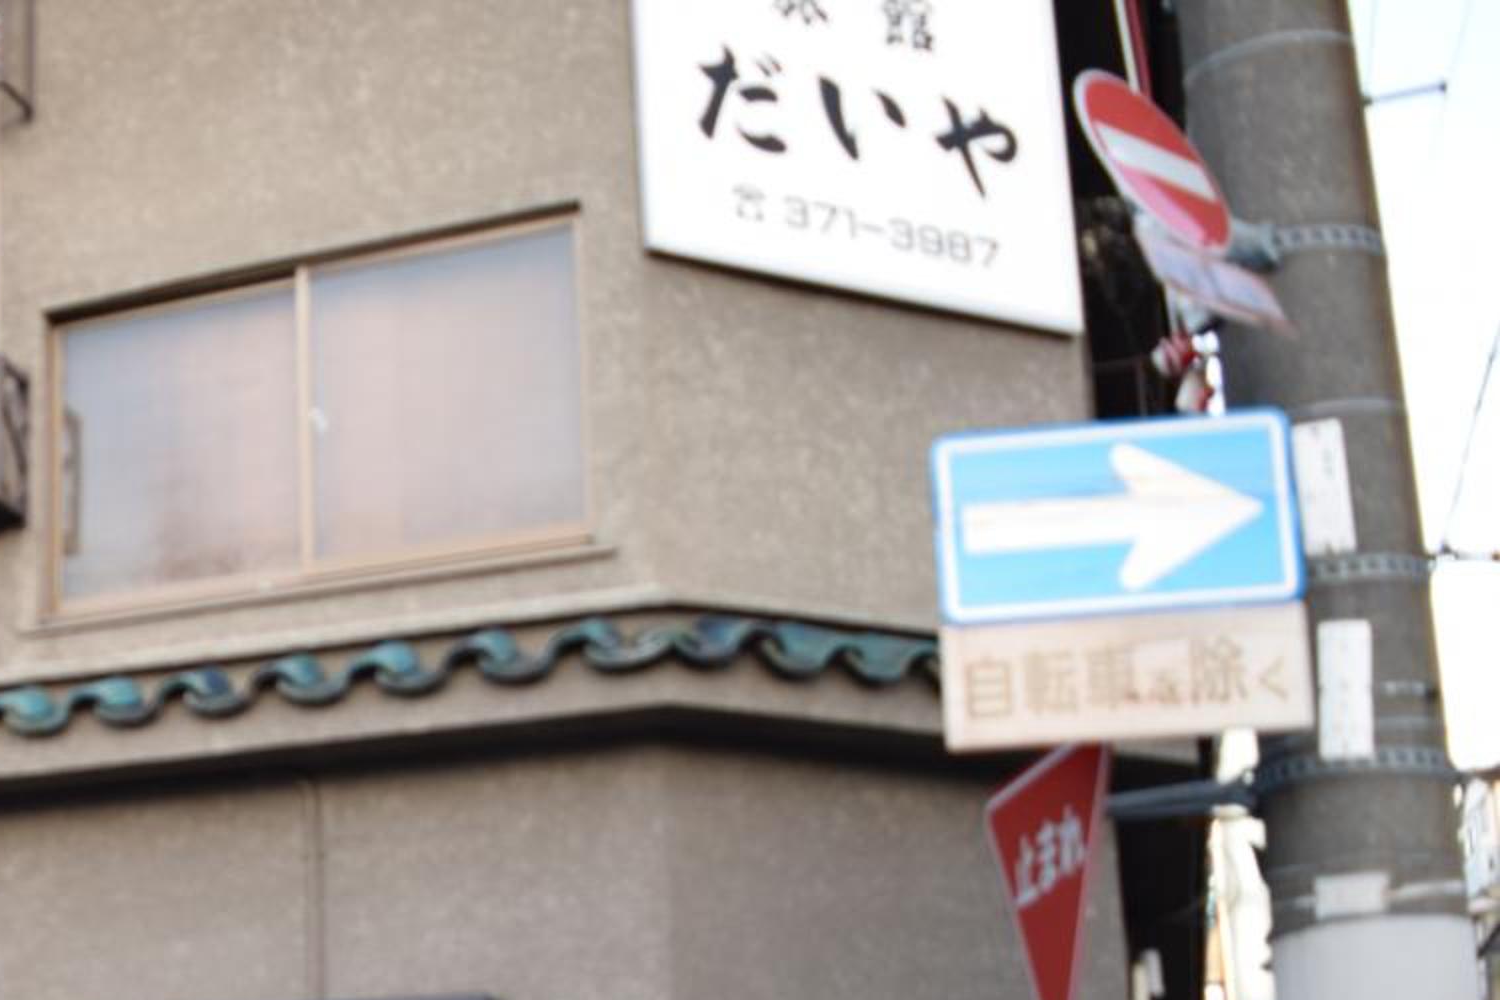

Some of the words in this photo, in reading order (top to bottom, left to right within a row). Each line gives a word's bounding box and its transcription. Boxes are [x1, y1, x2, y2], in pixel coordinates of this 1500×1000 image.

[697, 44, 1019, 199] だいや
[1015, 803, 1087, 906] 止まれ
